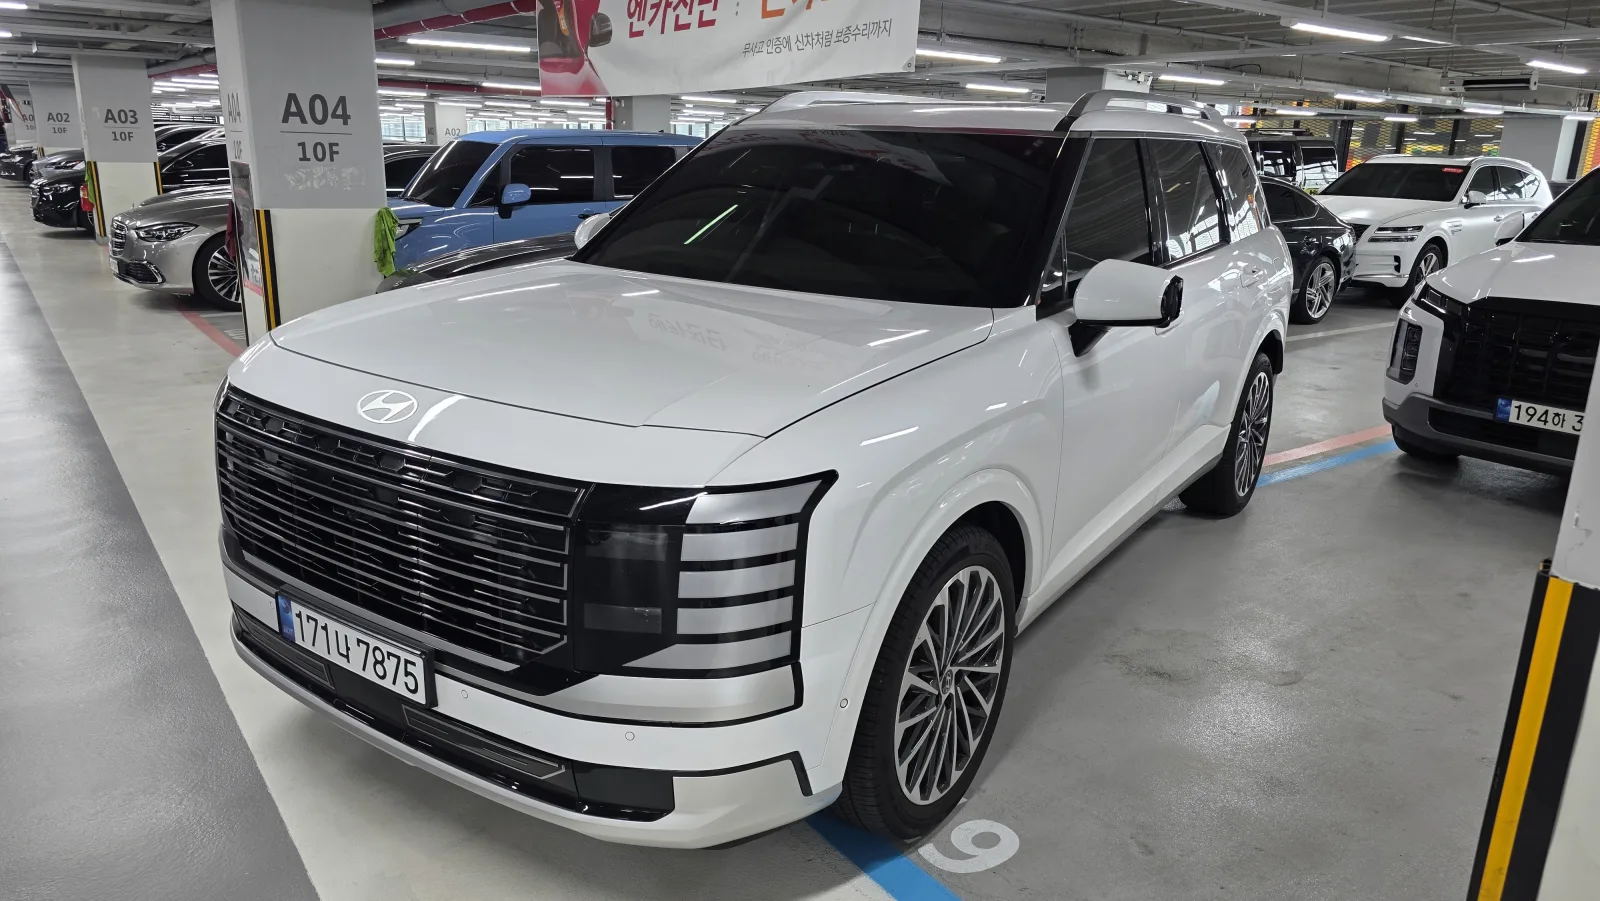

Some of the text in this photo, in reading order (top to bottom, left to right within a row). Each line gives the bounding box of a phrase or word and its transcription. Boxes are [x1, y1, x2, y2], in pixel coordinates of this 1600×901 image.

[742, 18, 893, 59] 무사고 인증에 신차처럼 보증수리까지
[104, 108, 139, 124] A03
[227, 92, 242, 123] A04
[281, 92, 351, 126] A04
[22, 113, 35, 122] A0
[47, 112, 71, 123] A02
[52, 126, 68, 134] 10F
[111, 131, 134, 142] 10F
[445, 127, 461, 136] A02
[297, 141, 340, 162] 10F
[1514, 404, 1566, 428] 194하
[295, 609, 419, 695] 171나 7875
